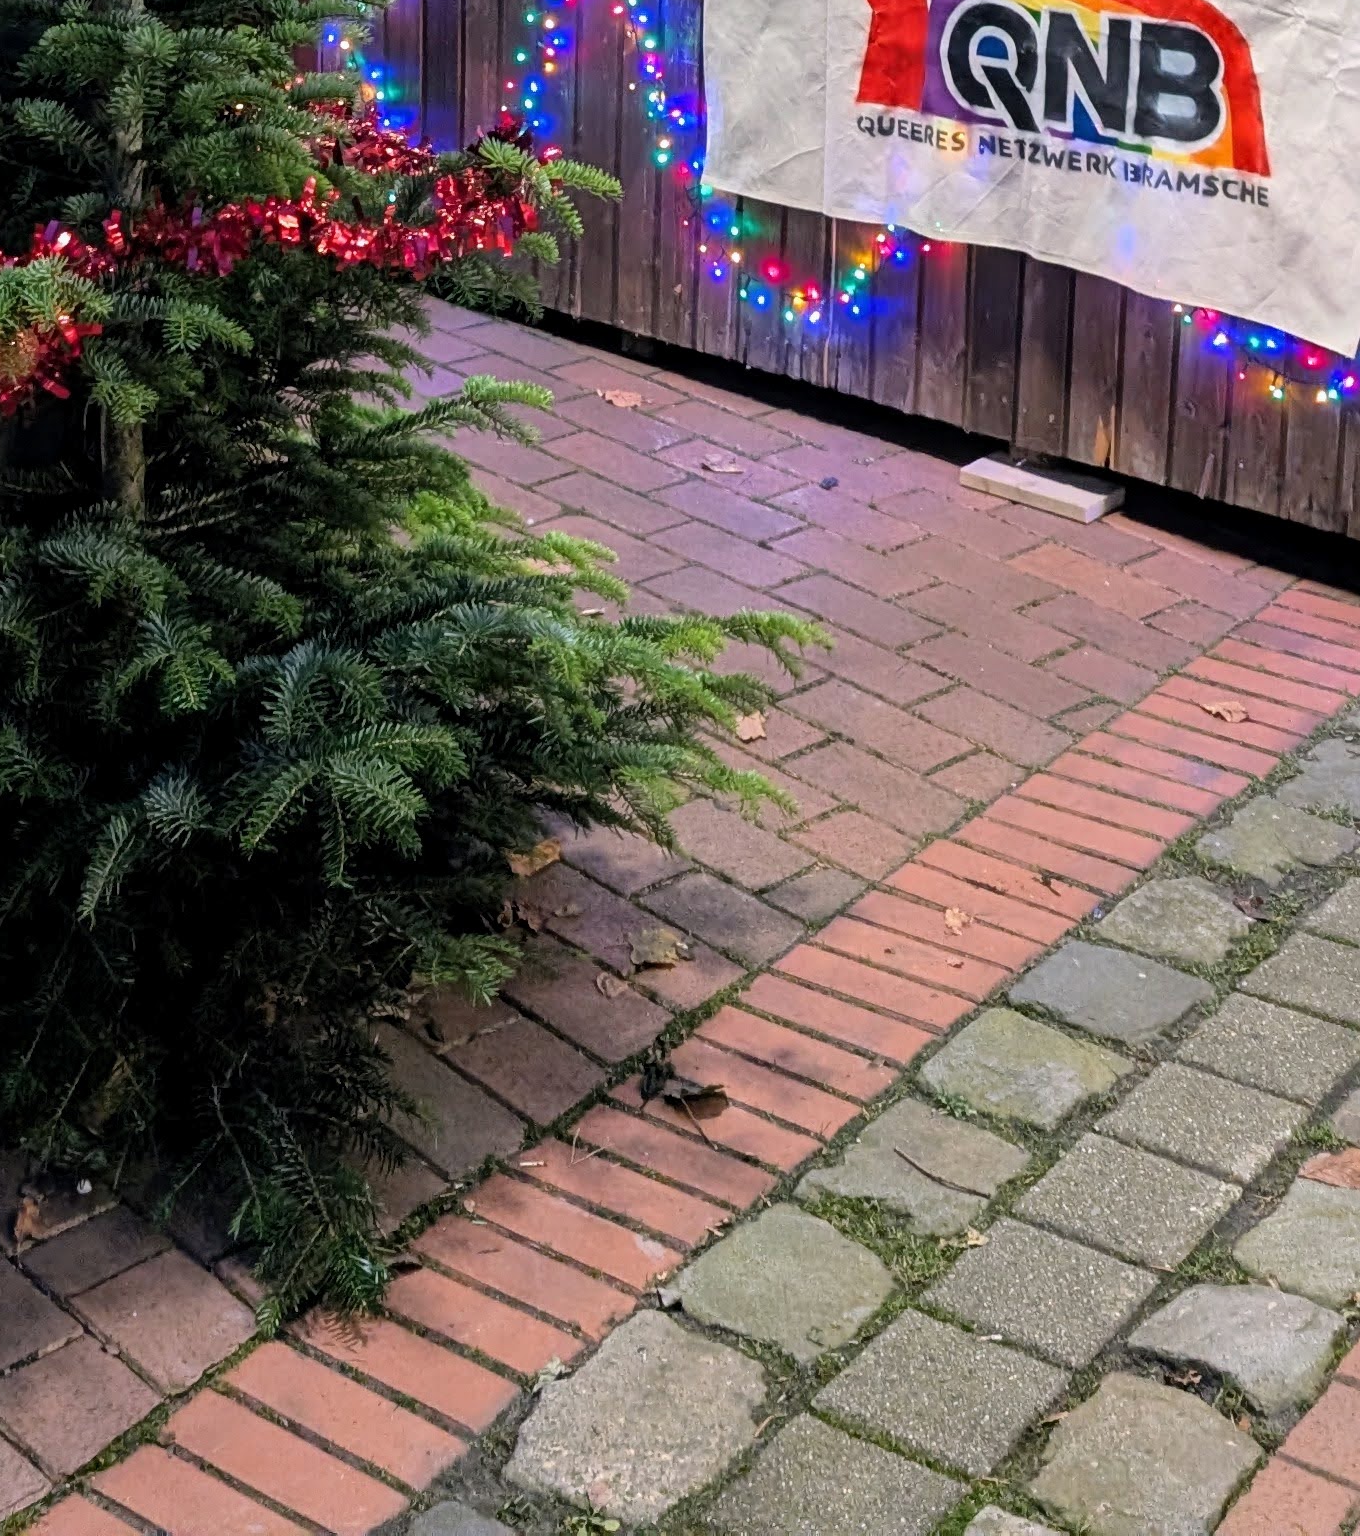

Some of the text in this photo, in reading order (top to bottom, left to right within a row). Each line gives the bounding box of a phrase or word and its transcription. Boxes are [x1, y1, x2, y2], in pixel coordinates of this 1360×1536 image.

[857, 115, 1270, 207] QUEERES NETZWERK BRAMSCHE
